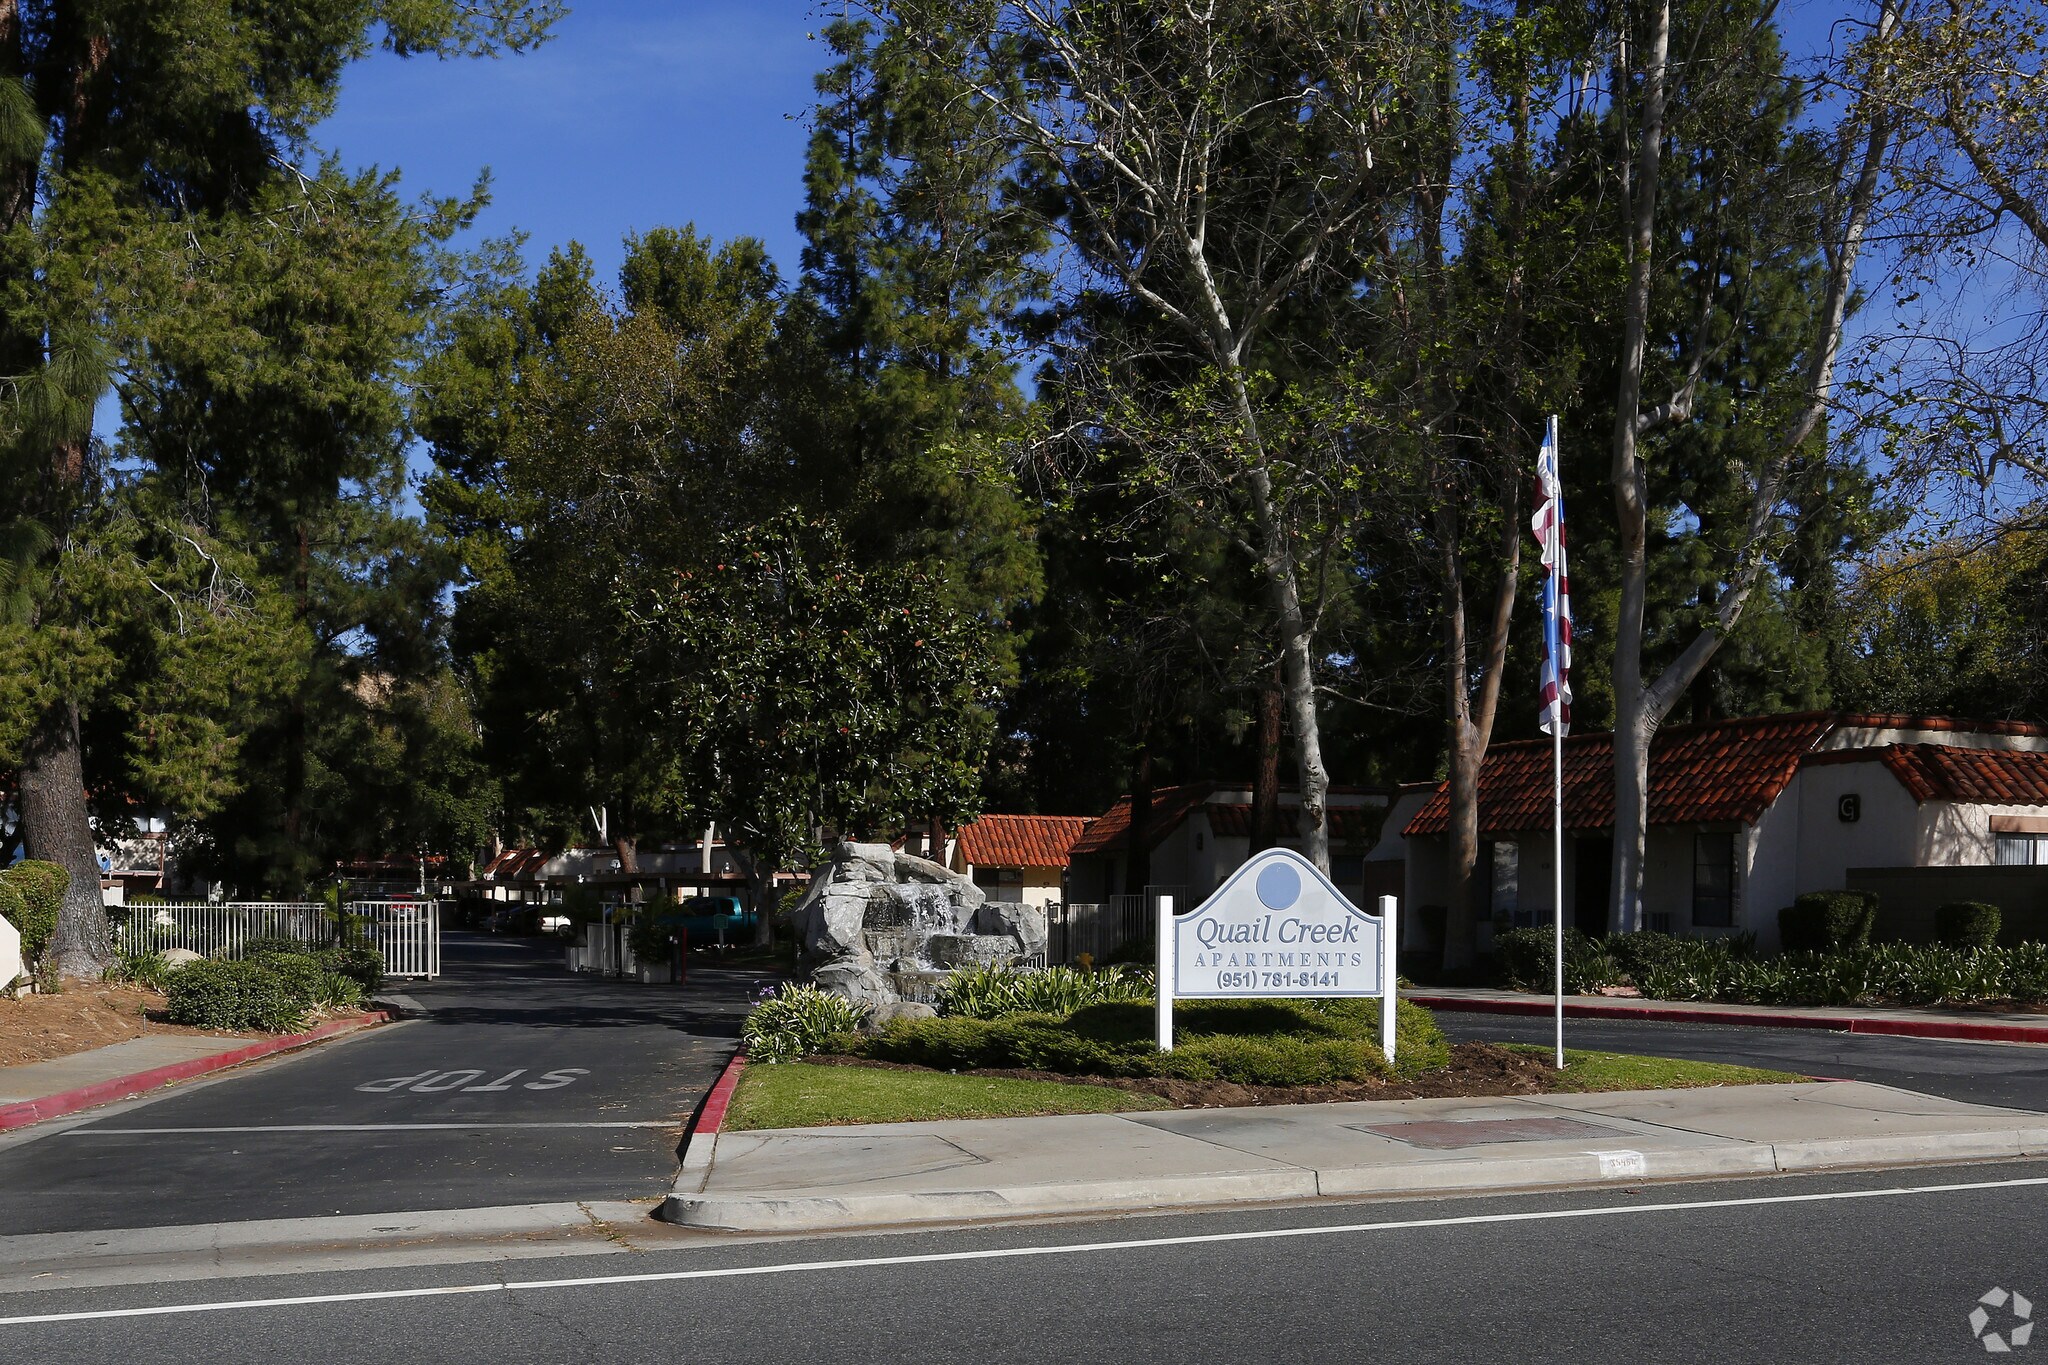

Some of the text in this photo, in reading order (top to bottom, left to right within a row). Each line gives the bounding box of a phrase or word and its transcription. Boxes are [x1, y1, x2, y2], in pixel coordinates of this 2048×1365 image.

[1841, 798, 1854, 820] G
[1196, 915, 1359, 950] Quail Creek
[1194, 952, 1362, 967] APARTMENTS
[1216, 970, 1339, 989] (951) 781-8141
[353, 1068, 591, 1092] STOP
